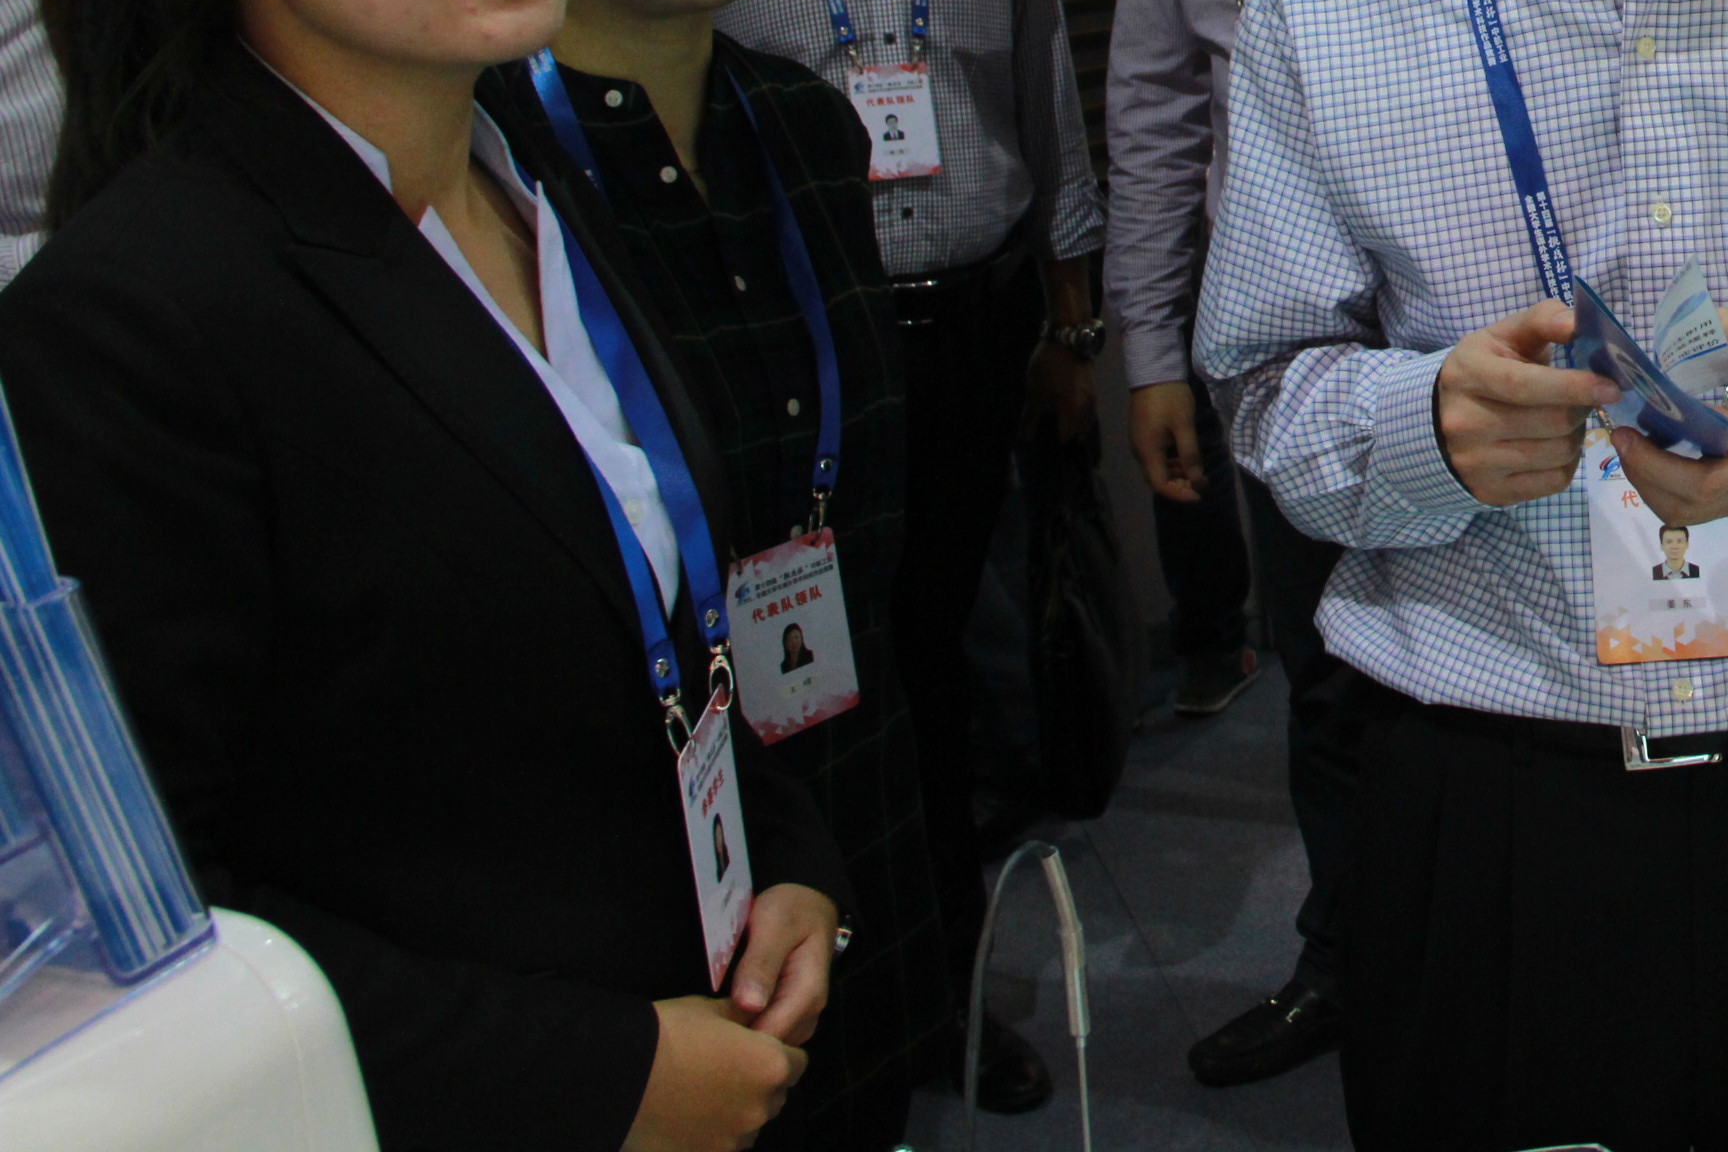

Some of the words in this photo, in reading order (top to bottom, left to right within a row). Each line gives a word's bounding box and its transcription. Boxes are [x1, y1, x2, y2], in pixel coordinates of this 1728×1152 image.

[751, 585, 822, 624] 代表队领队
